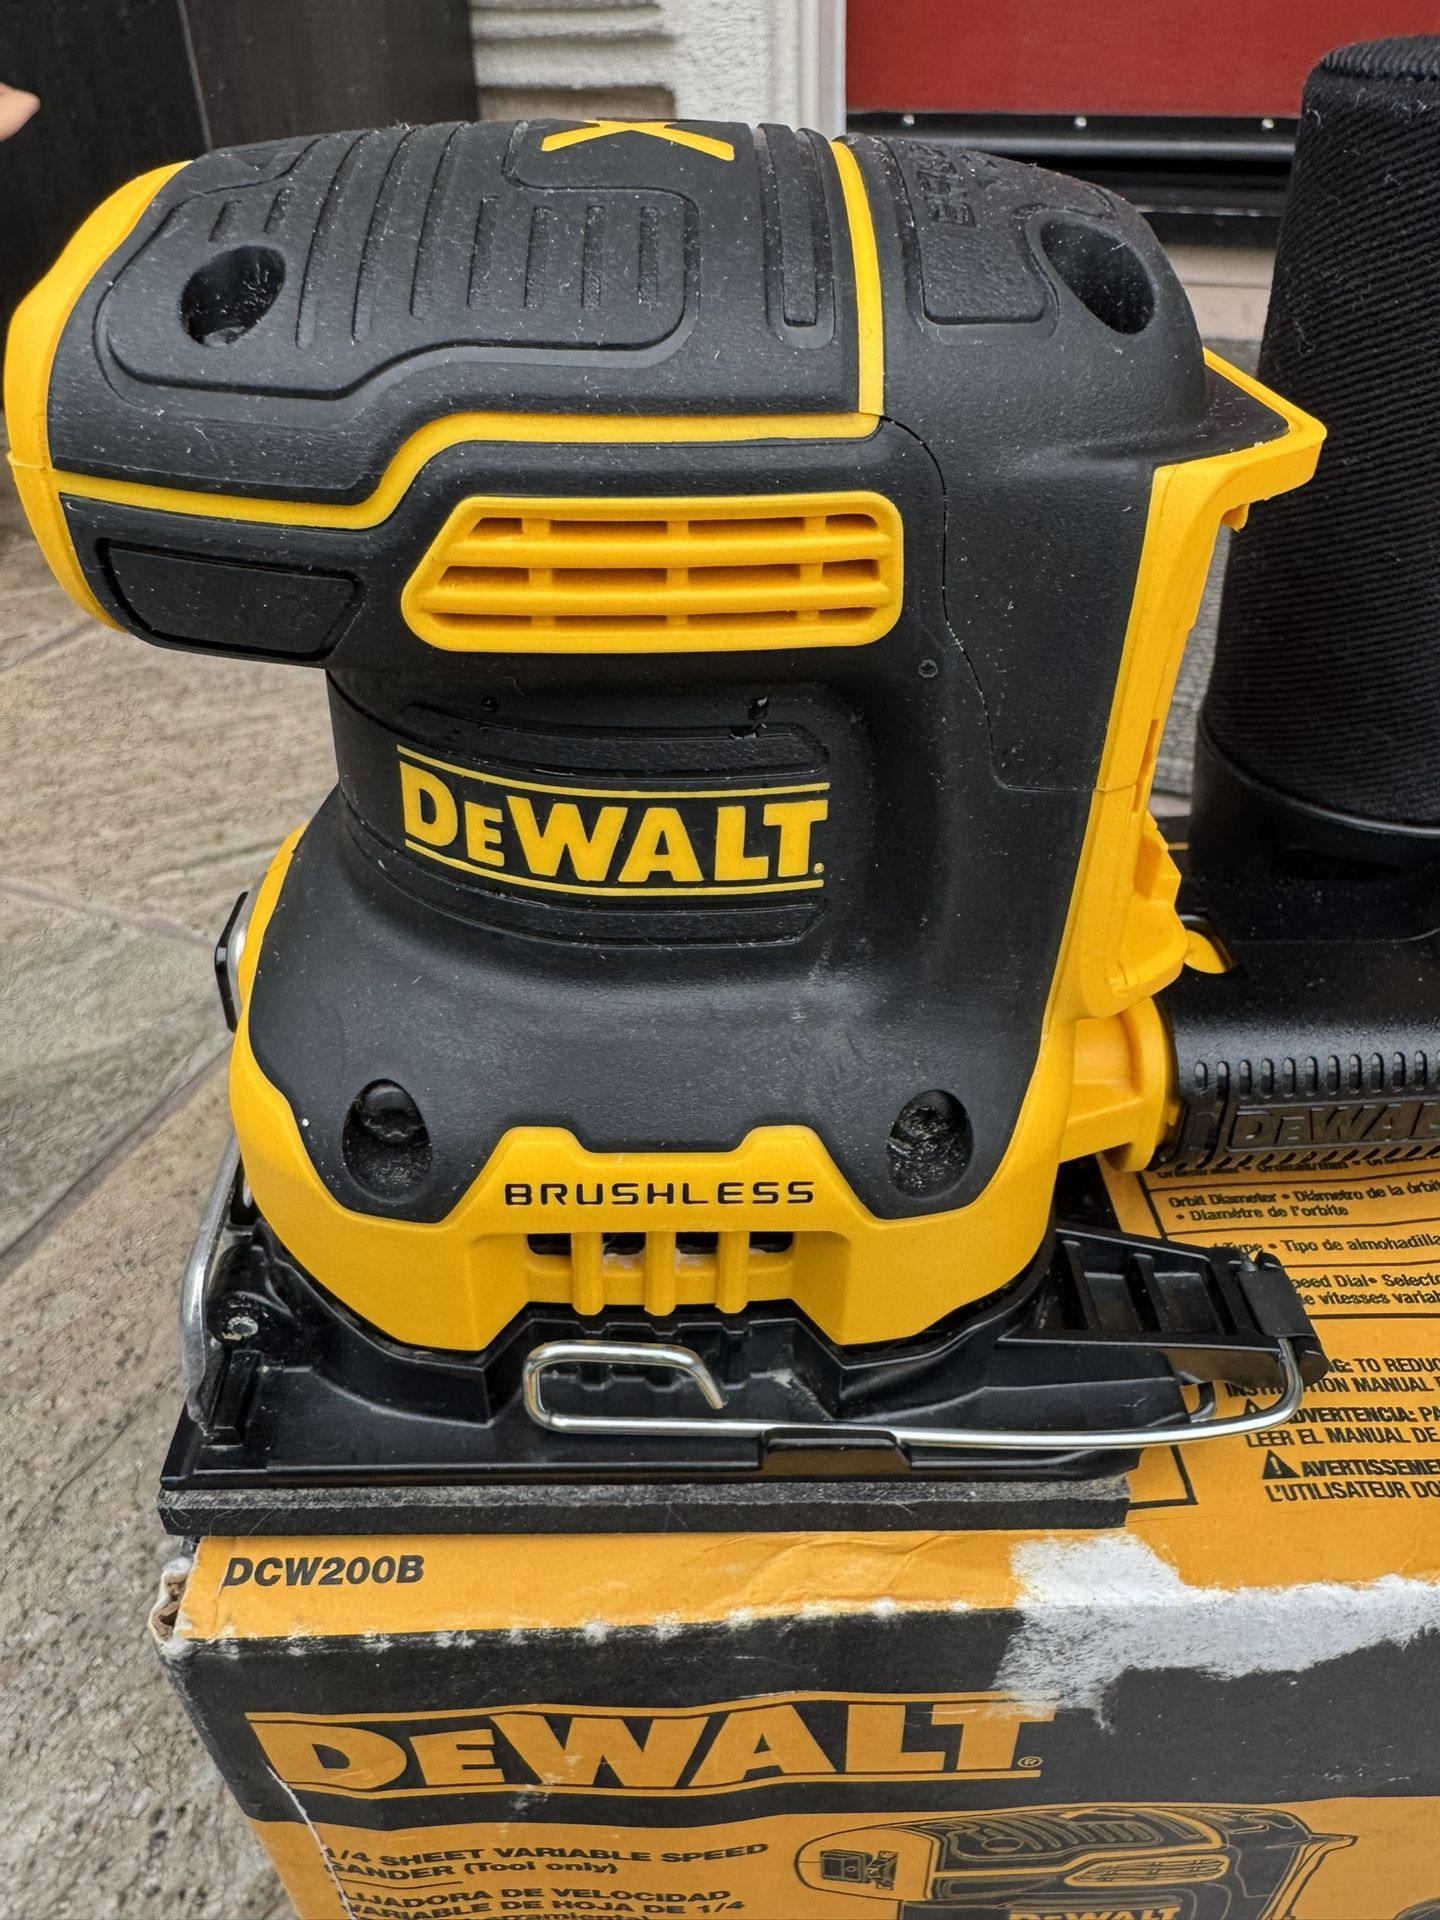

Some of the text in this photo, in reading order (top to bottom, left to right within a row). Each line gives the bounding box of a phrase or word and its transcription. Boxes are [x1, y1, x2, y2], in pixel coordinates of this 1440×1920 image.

[504, 1181, 815, 1206] BRUSHLESS
[1168, 1195, 1207, 1208] Orbit
[1208, 1192, 1277, 1205] Diameter
[1366, 1187, 1387, 1199] de
[1387, 1184, 1405, 1196] la
[1268, 1205, 1287, 1217] de
[1280, 1239, 1319, 1254] Tipo
[1322, 1238, 1343, 1251] de
[1319, 1290, 1391, 1304] vitesses
[1353, 1358, 1382, 1373] TO
[1351, 1375, 1435, 1393] MANUAL
[1245, 1426, 1440, 1448] LEER EL MANUAL DE
[222, 1554, 425, 1587] DCW200B
[379, 1848, 486, 1868] SHEET
[493, 1847, 652, 1862] VARIABLE
[661, 1843, 769, 1862] SPEED
[324, 1861, 619, 1880] SANDER (Tool only)
[501, 1887, 545, 1898] DE
[551, 1888, 731, 1903] VELOCIDAD
[501, 1900, 545, 1910] DE
[552, 1901, 635, 1913] HOJA
[643, 1904, 687, 1914] DE
[696, 1901, 747, 1914] 1/4
